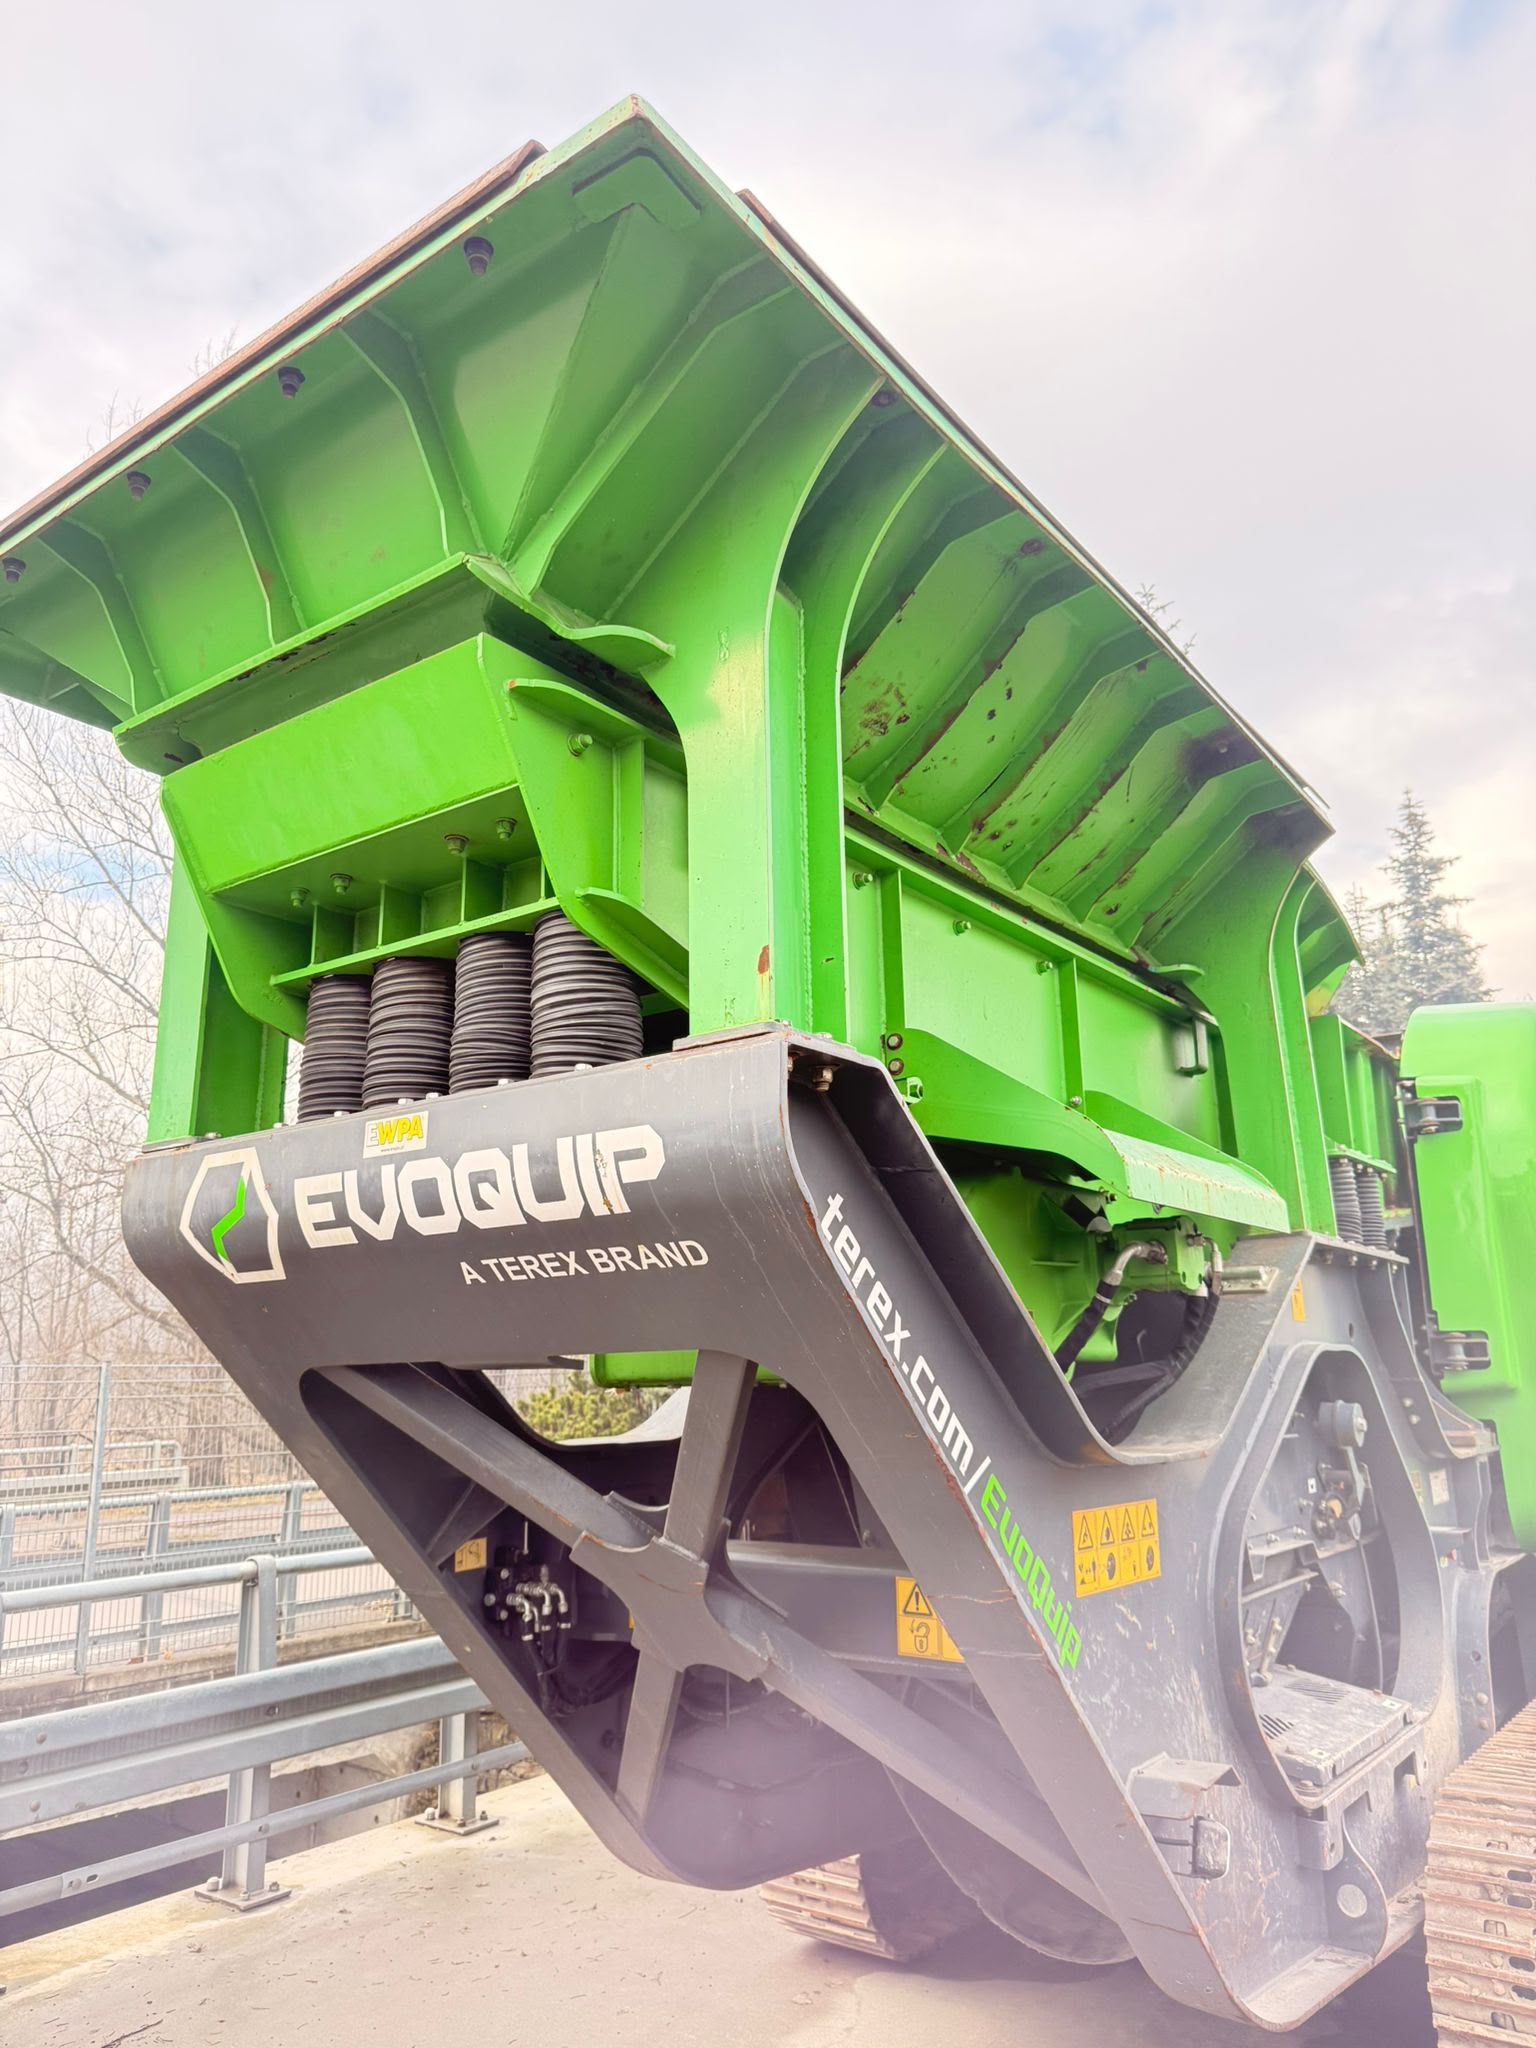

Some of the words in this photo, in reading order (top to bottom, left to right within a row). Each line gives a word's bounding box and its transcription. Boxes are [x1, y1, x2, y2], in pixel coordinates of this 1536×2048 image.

[366, 1115, 424, 1147] EWPA
[294, 1125, 666, 1249] EVOQUIP
[460, 1262, 483, 1285] A
[484, 1250, 589, 1283] TEREX
[597, 1240, 709, 1274] BRAND
